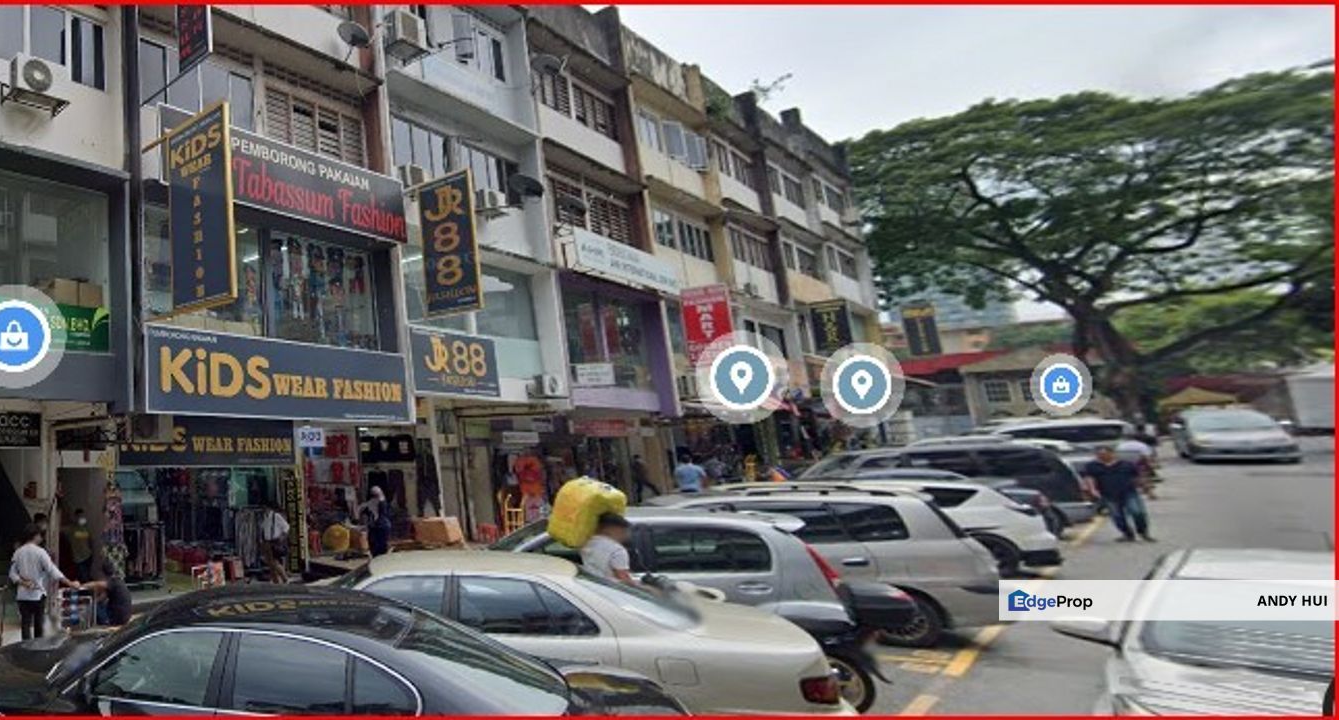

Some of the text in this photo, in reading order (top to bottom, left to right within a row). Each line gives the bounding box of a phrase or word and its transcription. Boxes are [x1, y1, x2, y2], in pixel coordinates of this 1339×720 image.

[231, 136, 315, 176] PEMBORONG
[233, 156, 406, 238] Tabassum Fashion
[160, 346, 402, 403] KiDS WEAR FASHION
[191, 435, 234, 452] WEAR
[236, 437, 292, 454] FASHION
